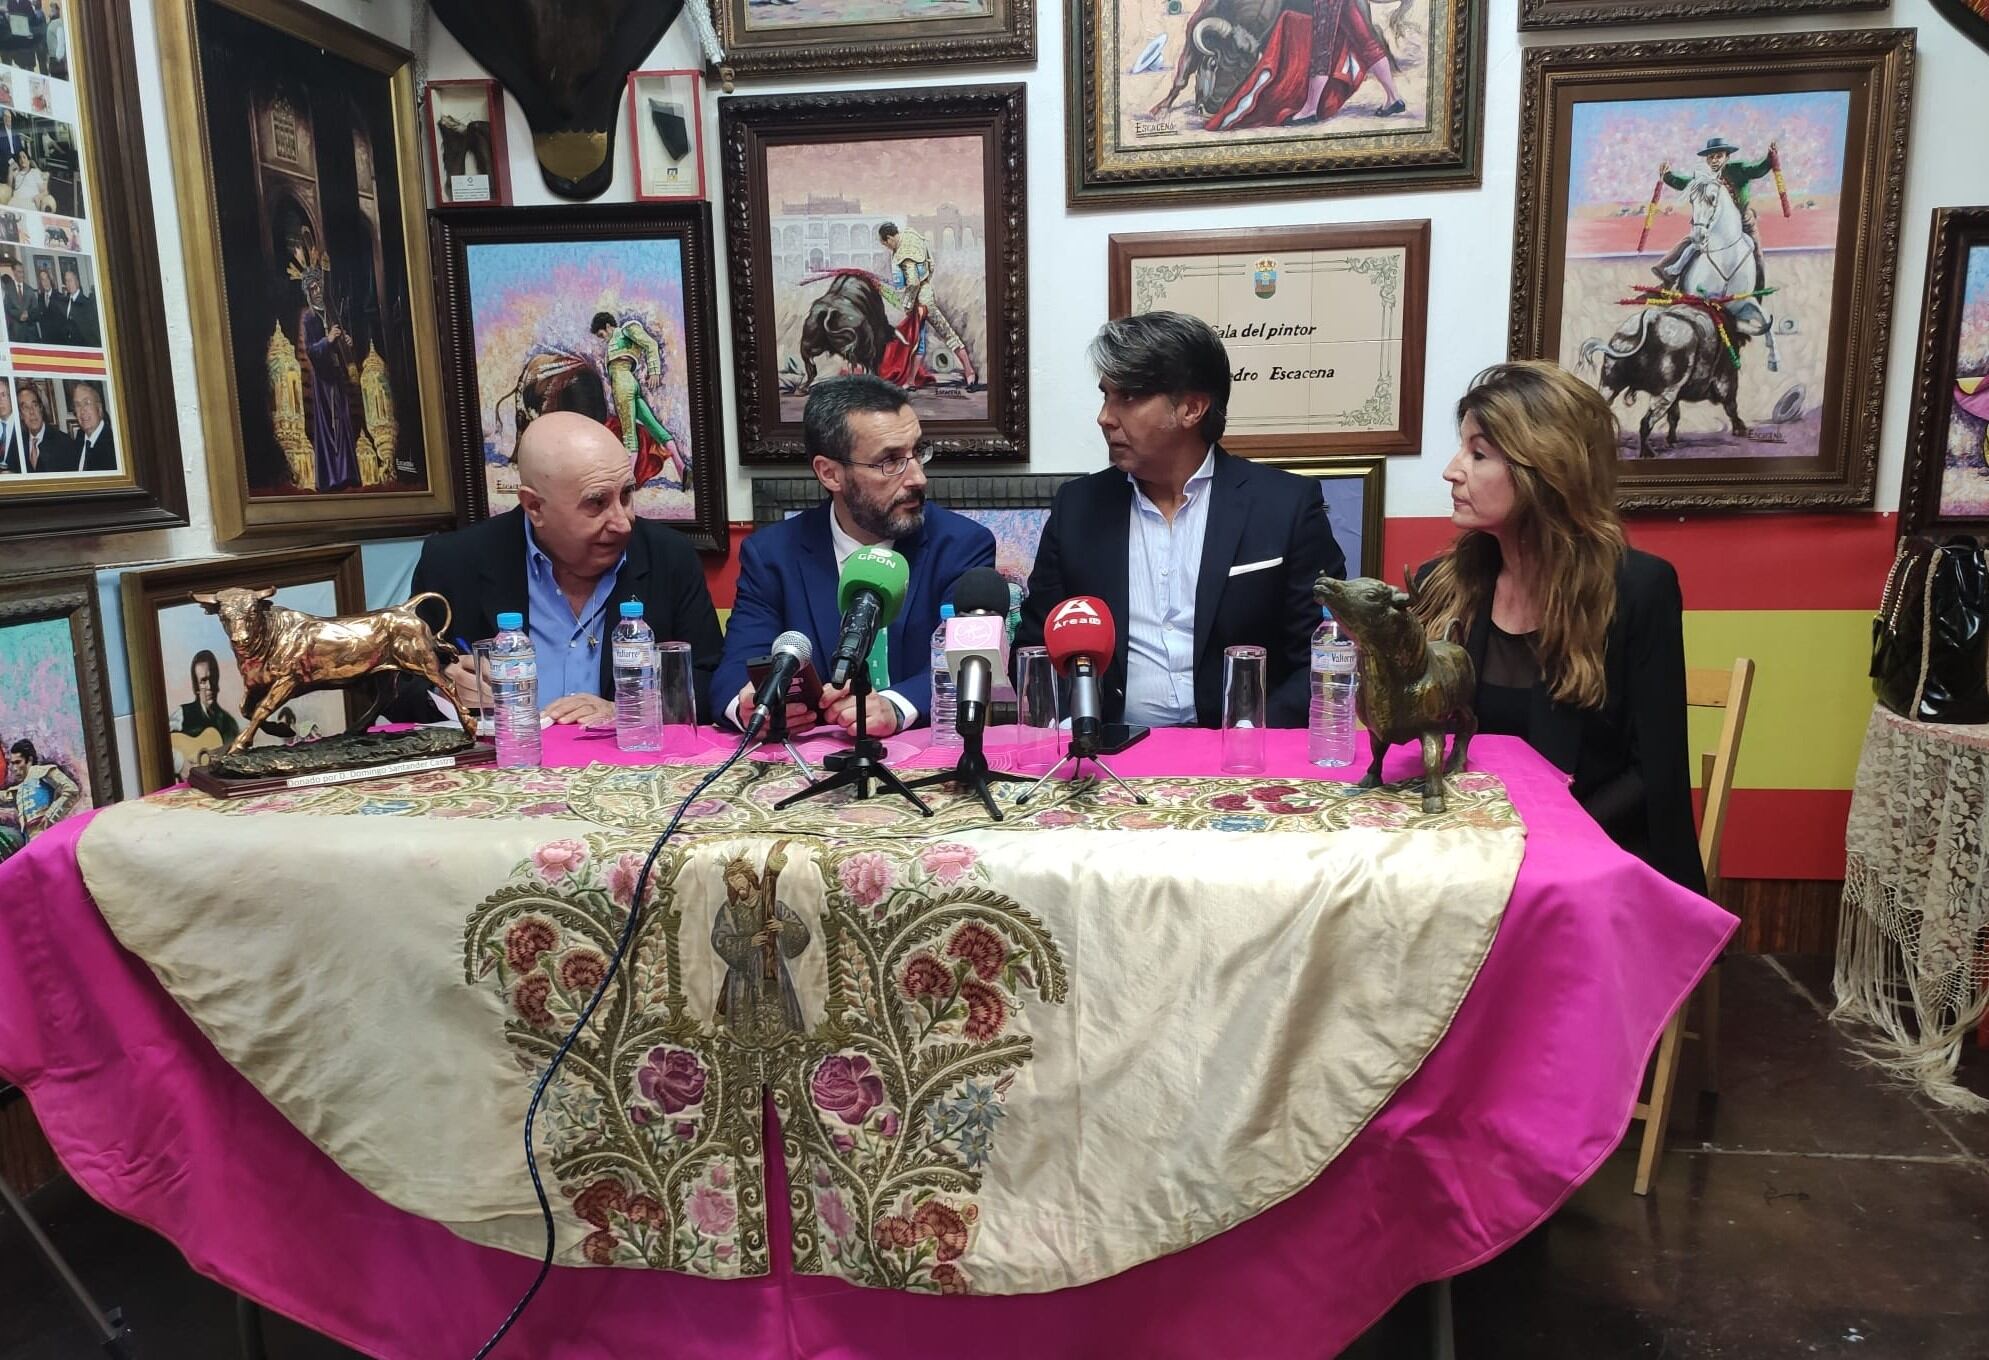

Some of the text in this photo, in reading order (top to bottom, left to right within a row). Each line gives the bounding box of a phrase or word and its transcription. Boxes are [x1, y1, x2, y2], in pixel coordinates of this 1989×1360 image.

[1135, 122, 1175, 133] ESCACENA
[1241, 323, 1266, 338] del
[1265, 323, 1317, 341] pintor
[1230, 366, 1335, 381] dro Escacena
[857, 553, 896, 569] GPON
[288, 776, 320, 787] Donado
[323, 774, 337, 783] por
[350, 767, 387, 778] Domingo
[388, 762, 427, 773] Santander
[430, 758, 454, 767] Castro
